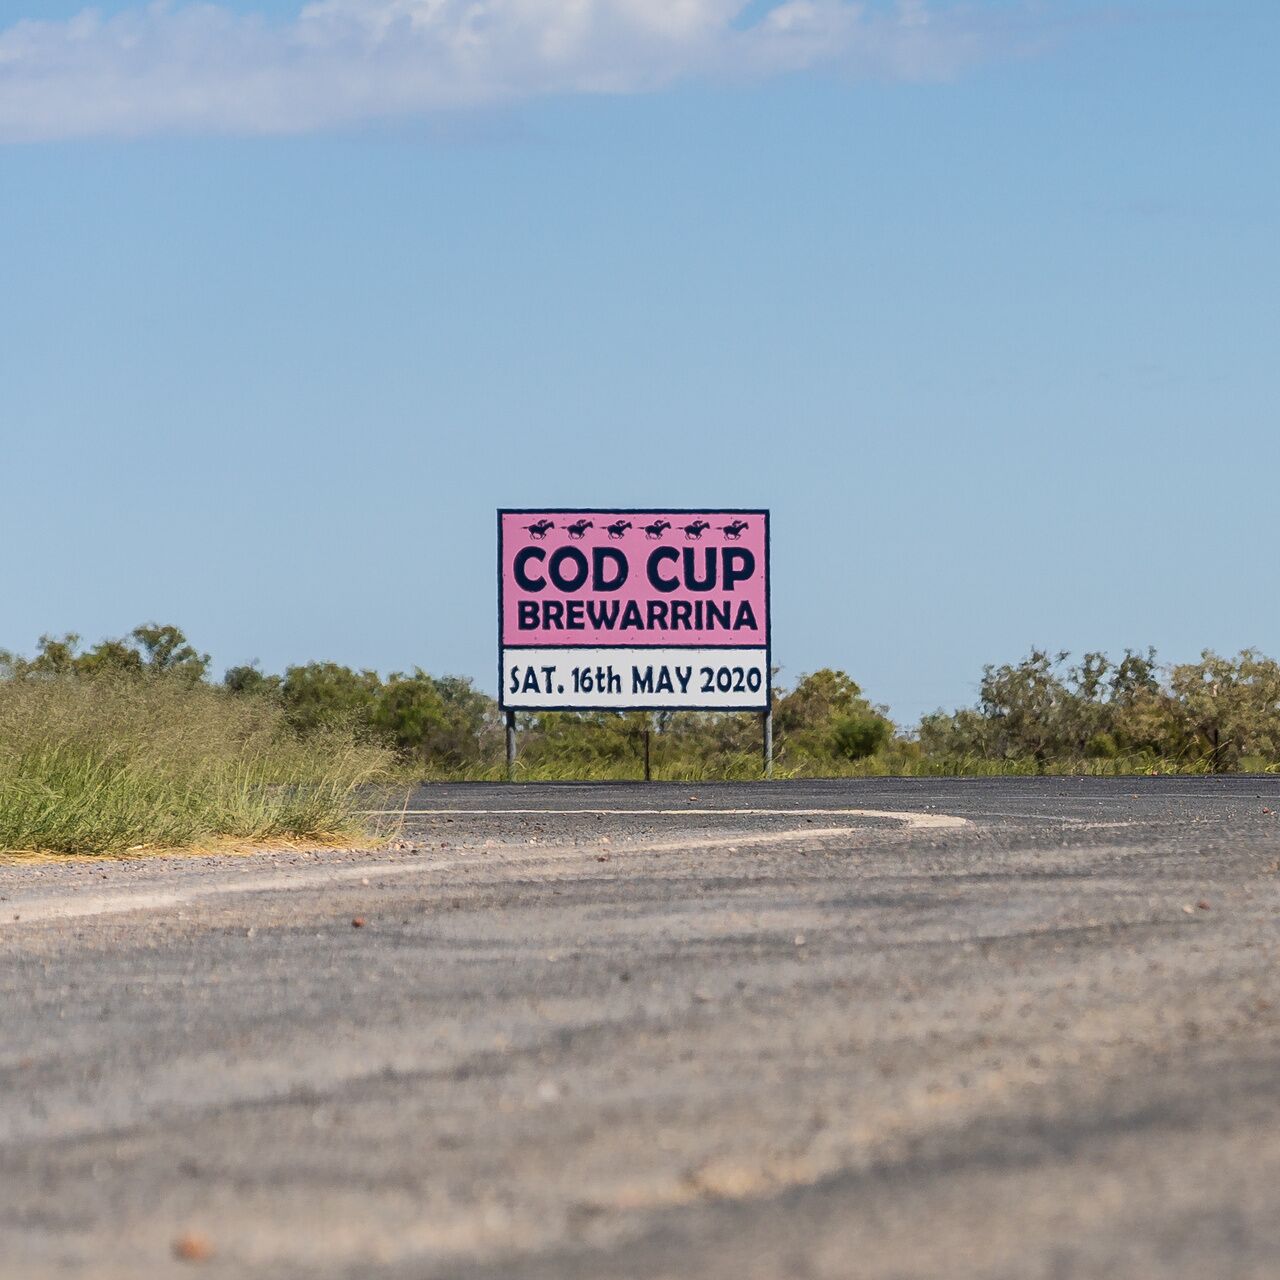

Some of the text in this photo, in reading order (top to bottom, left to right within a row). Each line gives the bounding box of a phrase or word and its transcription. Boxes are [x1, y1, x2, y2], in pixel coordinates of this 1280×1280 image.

[513, 545, 756, 593] COD CUP
[517, 600, 759, 631] BREWARRINA
[509, 665, 762, 694] SAT. 16th MAY 2020
